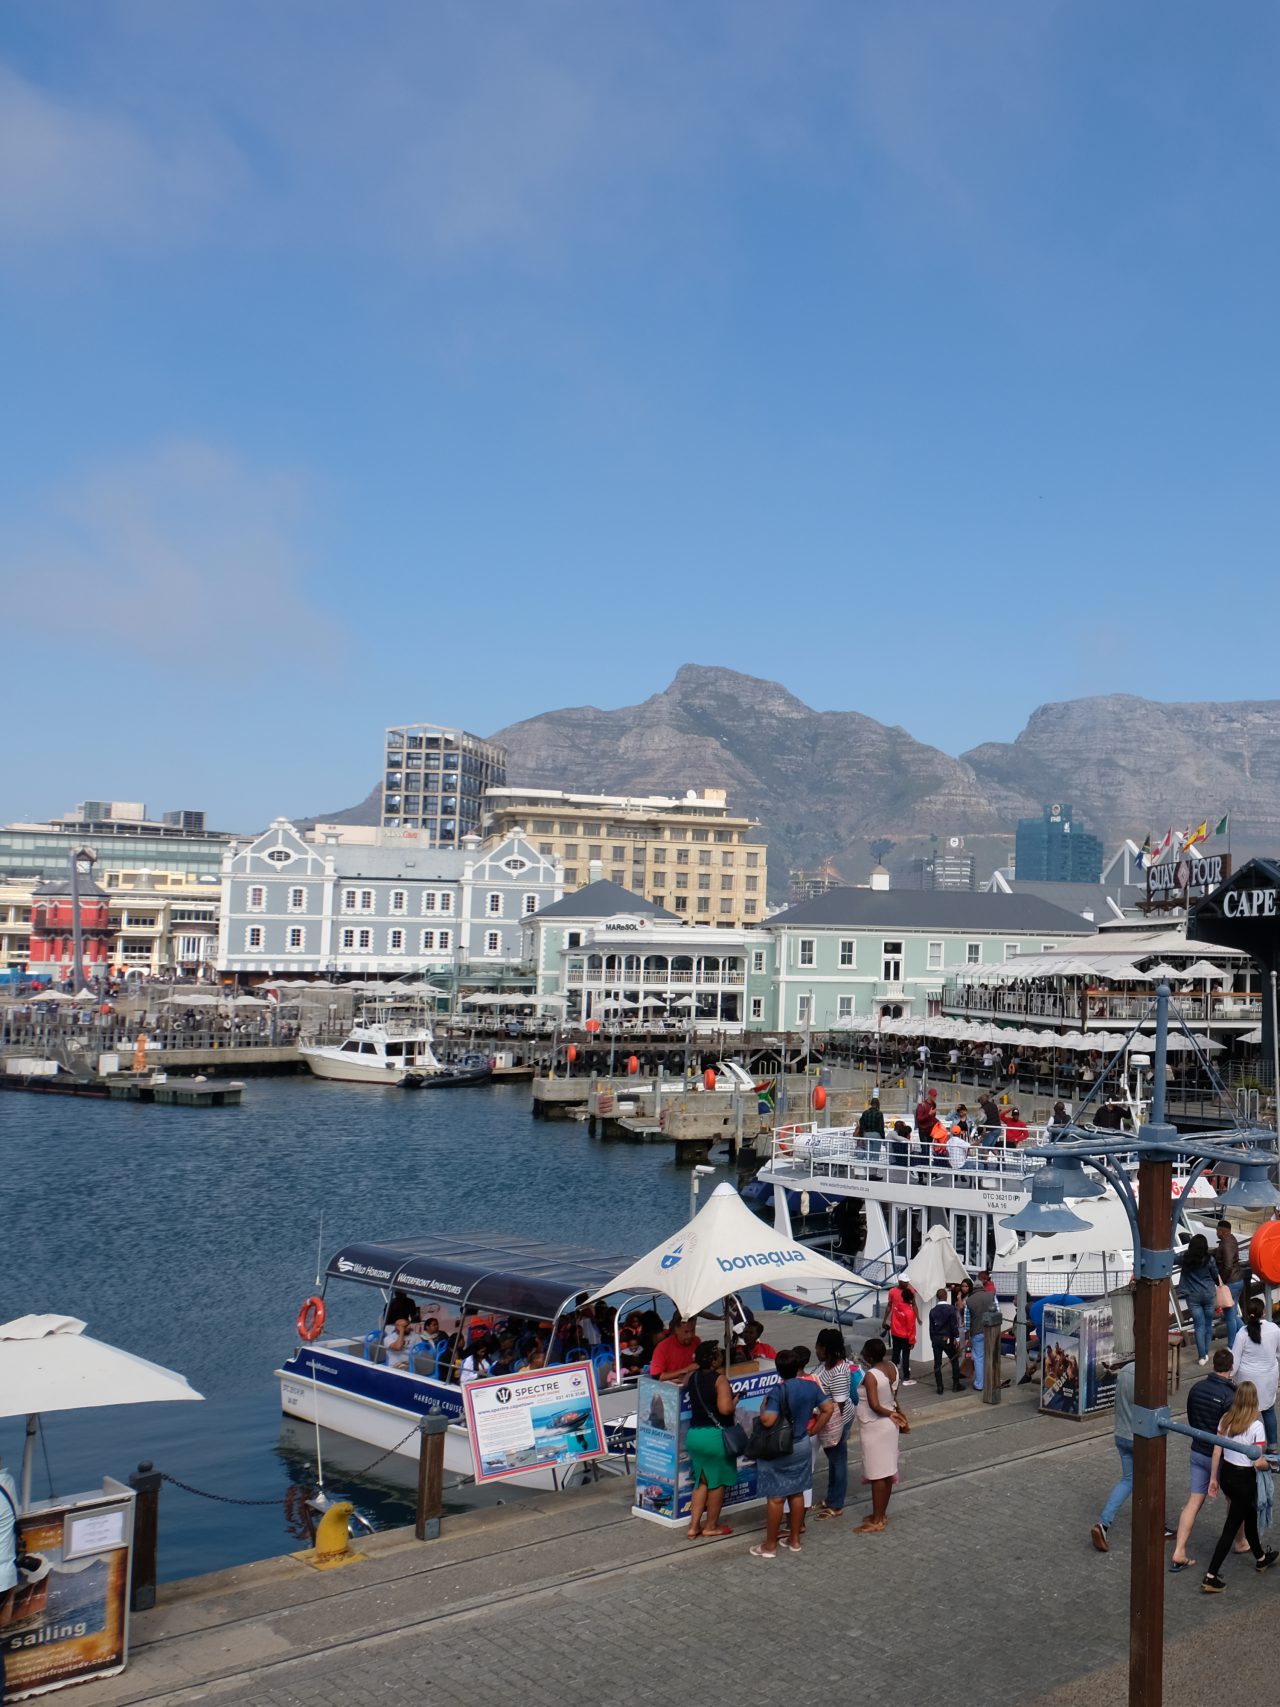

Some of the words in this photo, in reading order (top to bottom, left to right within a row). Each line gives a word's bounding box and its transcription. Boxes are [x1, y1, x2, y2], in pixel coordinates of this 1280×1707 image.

[1149, 864, 1177, 891] QUAY
[1190, 856, 1222, 886] FOUR
[1223, 888, 1277, 918] CAPE
[716, 1249, 806, 1273] bonaqua
[514, 1381, 560, 1397] SPECTRE
[730, 1378, 758, 1394] OAT
[746, 1389, 764, 1397] PRIVATE
[413, 1392, 440, 1407] HARBOUR
[10, 1622, 87, 1649] sailing
